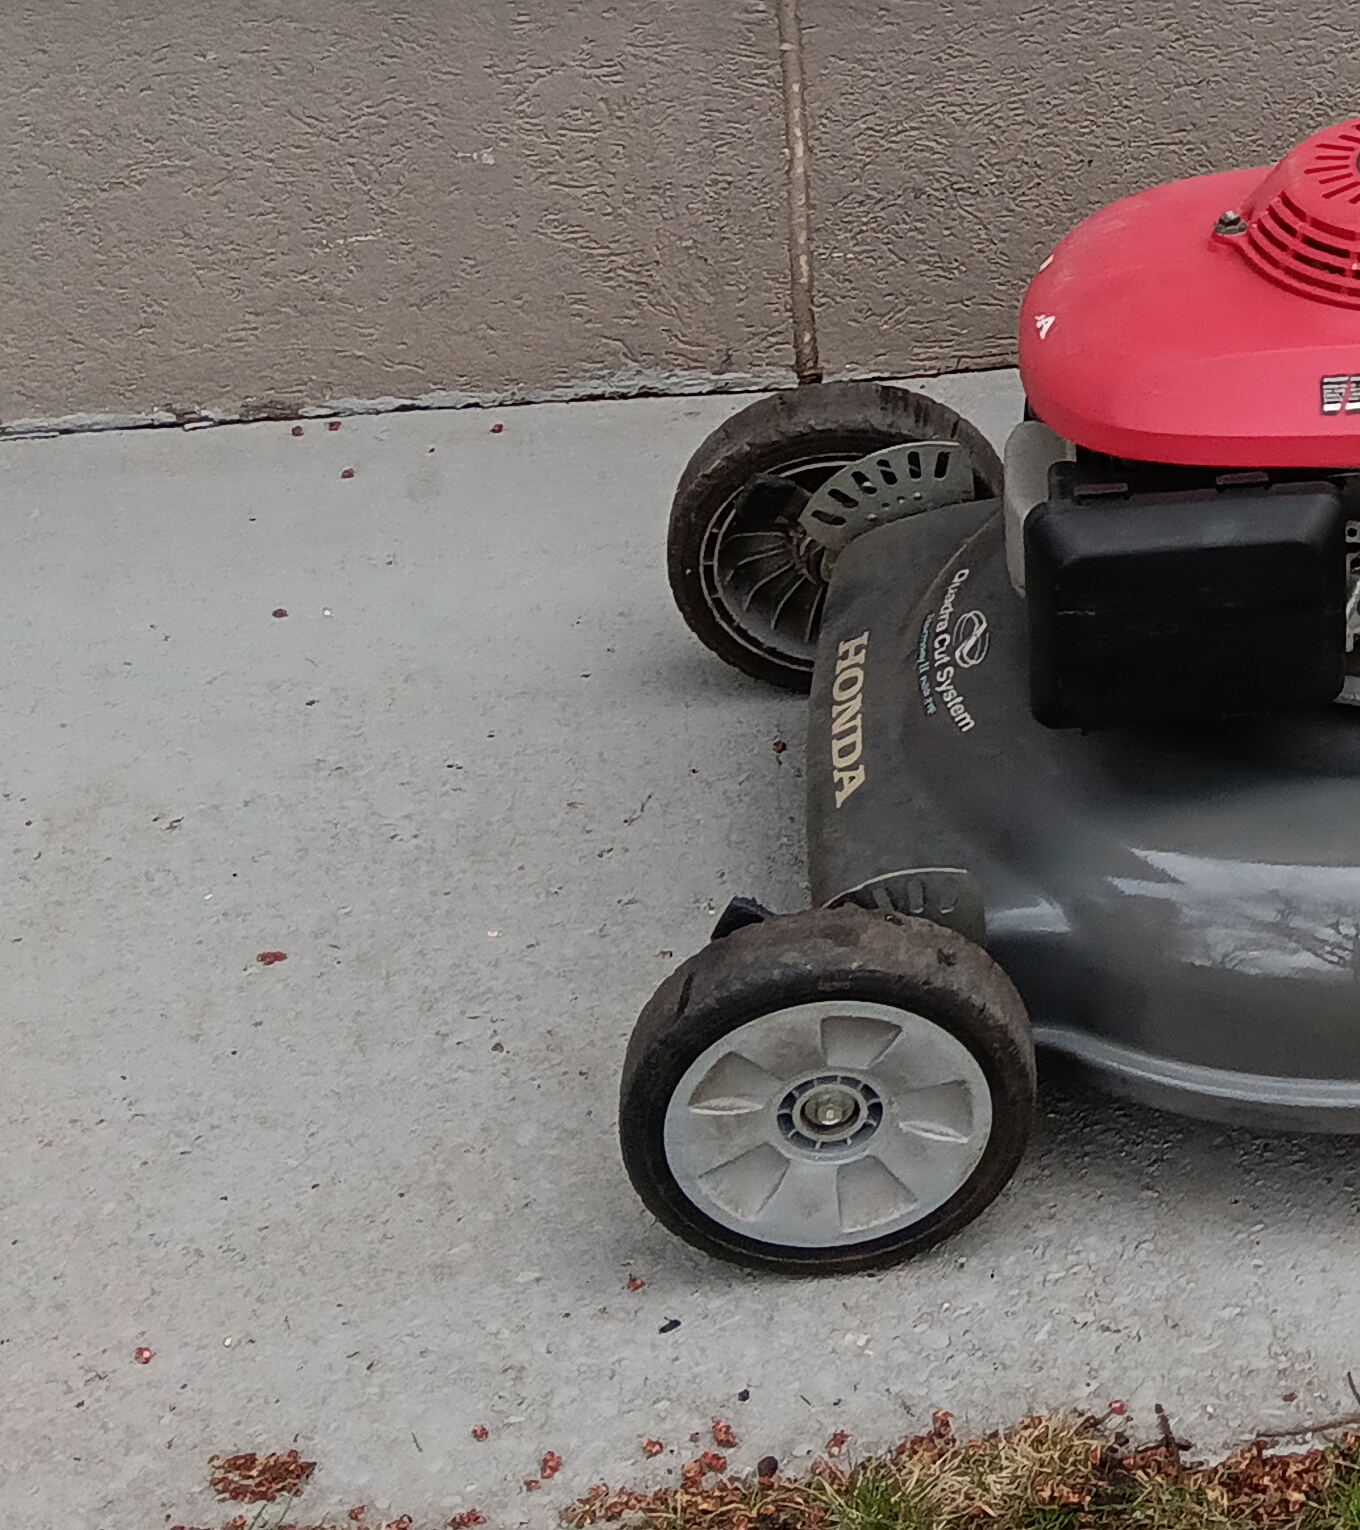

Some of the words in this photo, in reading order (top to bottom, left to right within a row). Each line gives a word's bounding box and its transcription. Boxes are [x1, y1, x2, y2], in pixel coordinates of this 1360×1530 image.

[934, 634, 950, 667] Cut
[831, 631, 870, 808] HONDA
[935, 666, 975, 732] System
